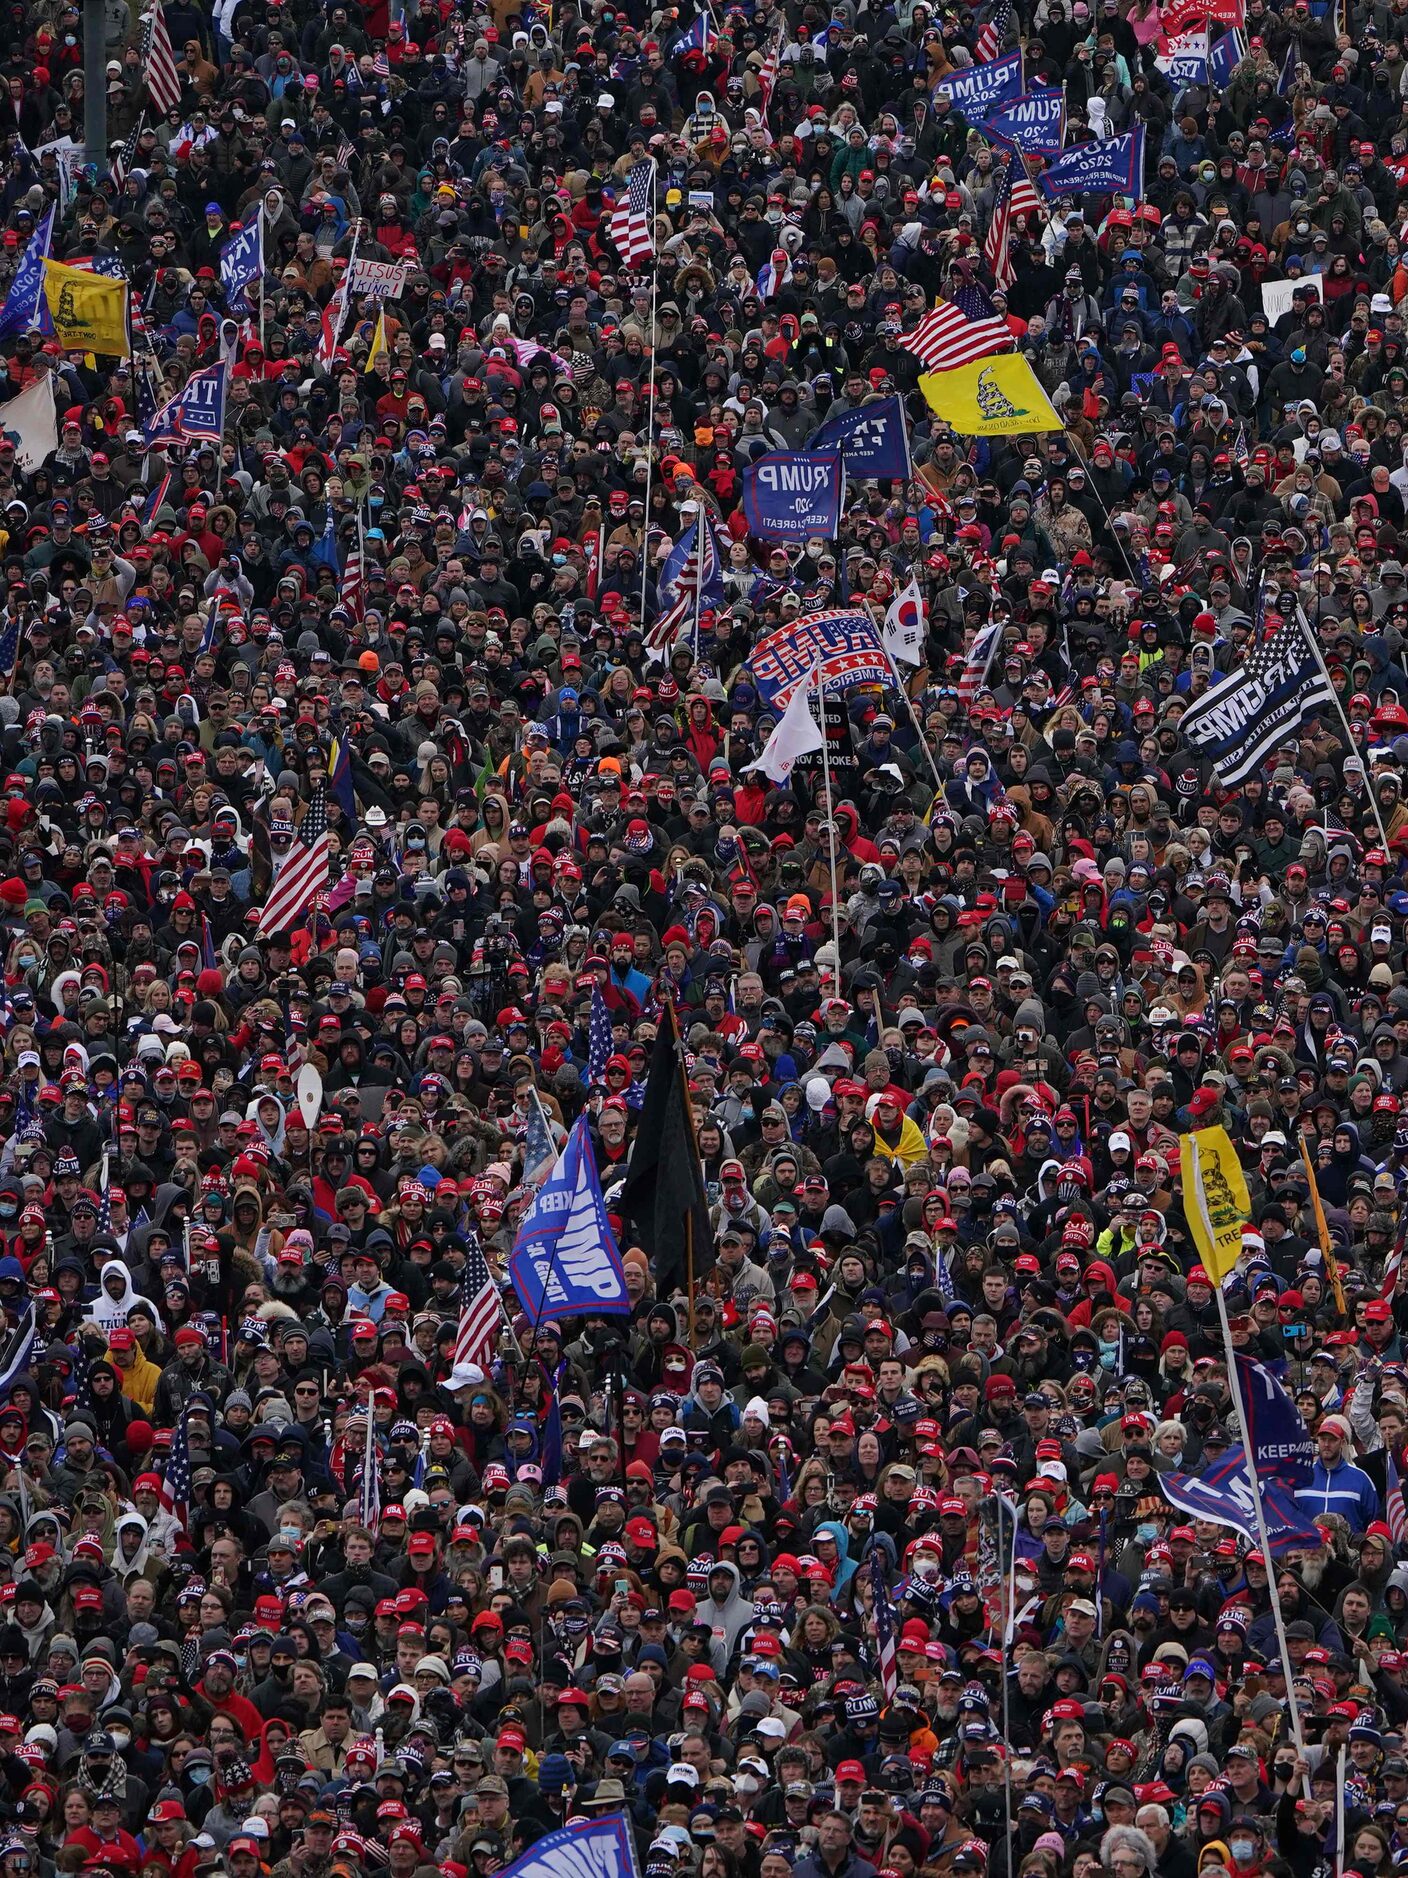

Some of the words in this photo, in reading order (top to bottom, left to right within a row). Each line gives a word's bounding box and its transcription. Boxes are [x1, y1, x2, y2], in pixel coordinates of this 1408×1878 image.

[355, 262, 404, 280] JESUS
[356, 280, 398, 297] KING!
[826, 741, 840, 750] ON
[825, 756, 851, 765] JOKE
[1217, 1231, 1240, 1249] TRE
[1126, 1414, 1140, 1424] USA
[1257, 1444, 1289, 1459] KEEP
[386, 1506, 402, 1514] USA
[1068, 1556, 1086, 1566] MAGA
